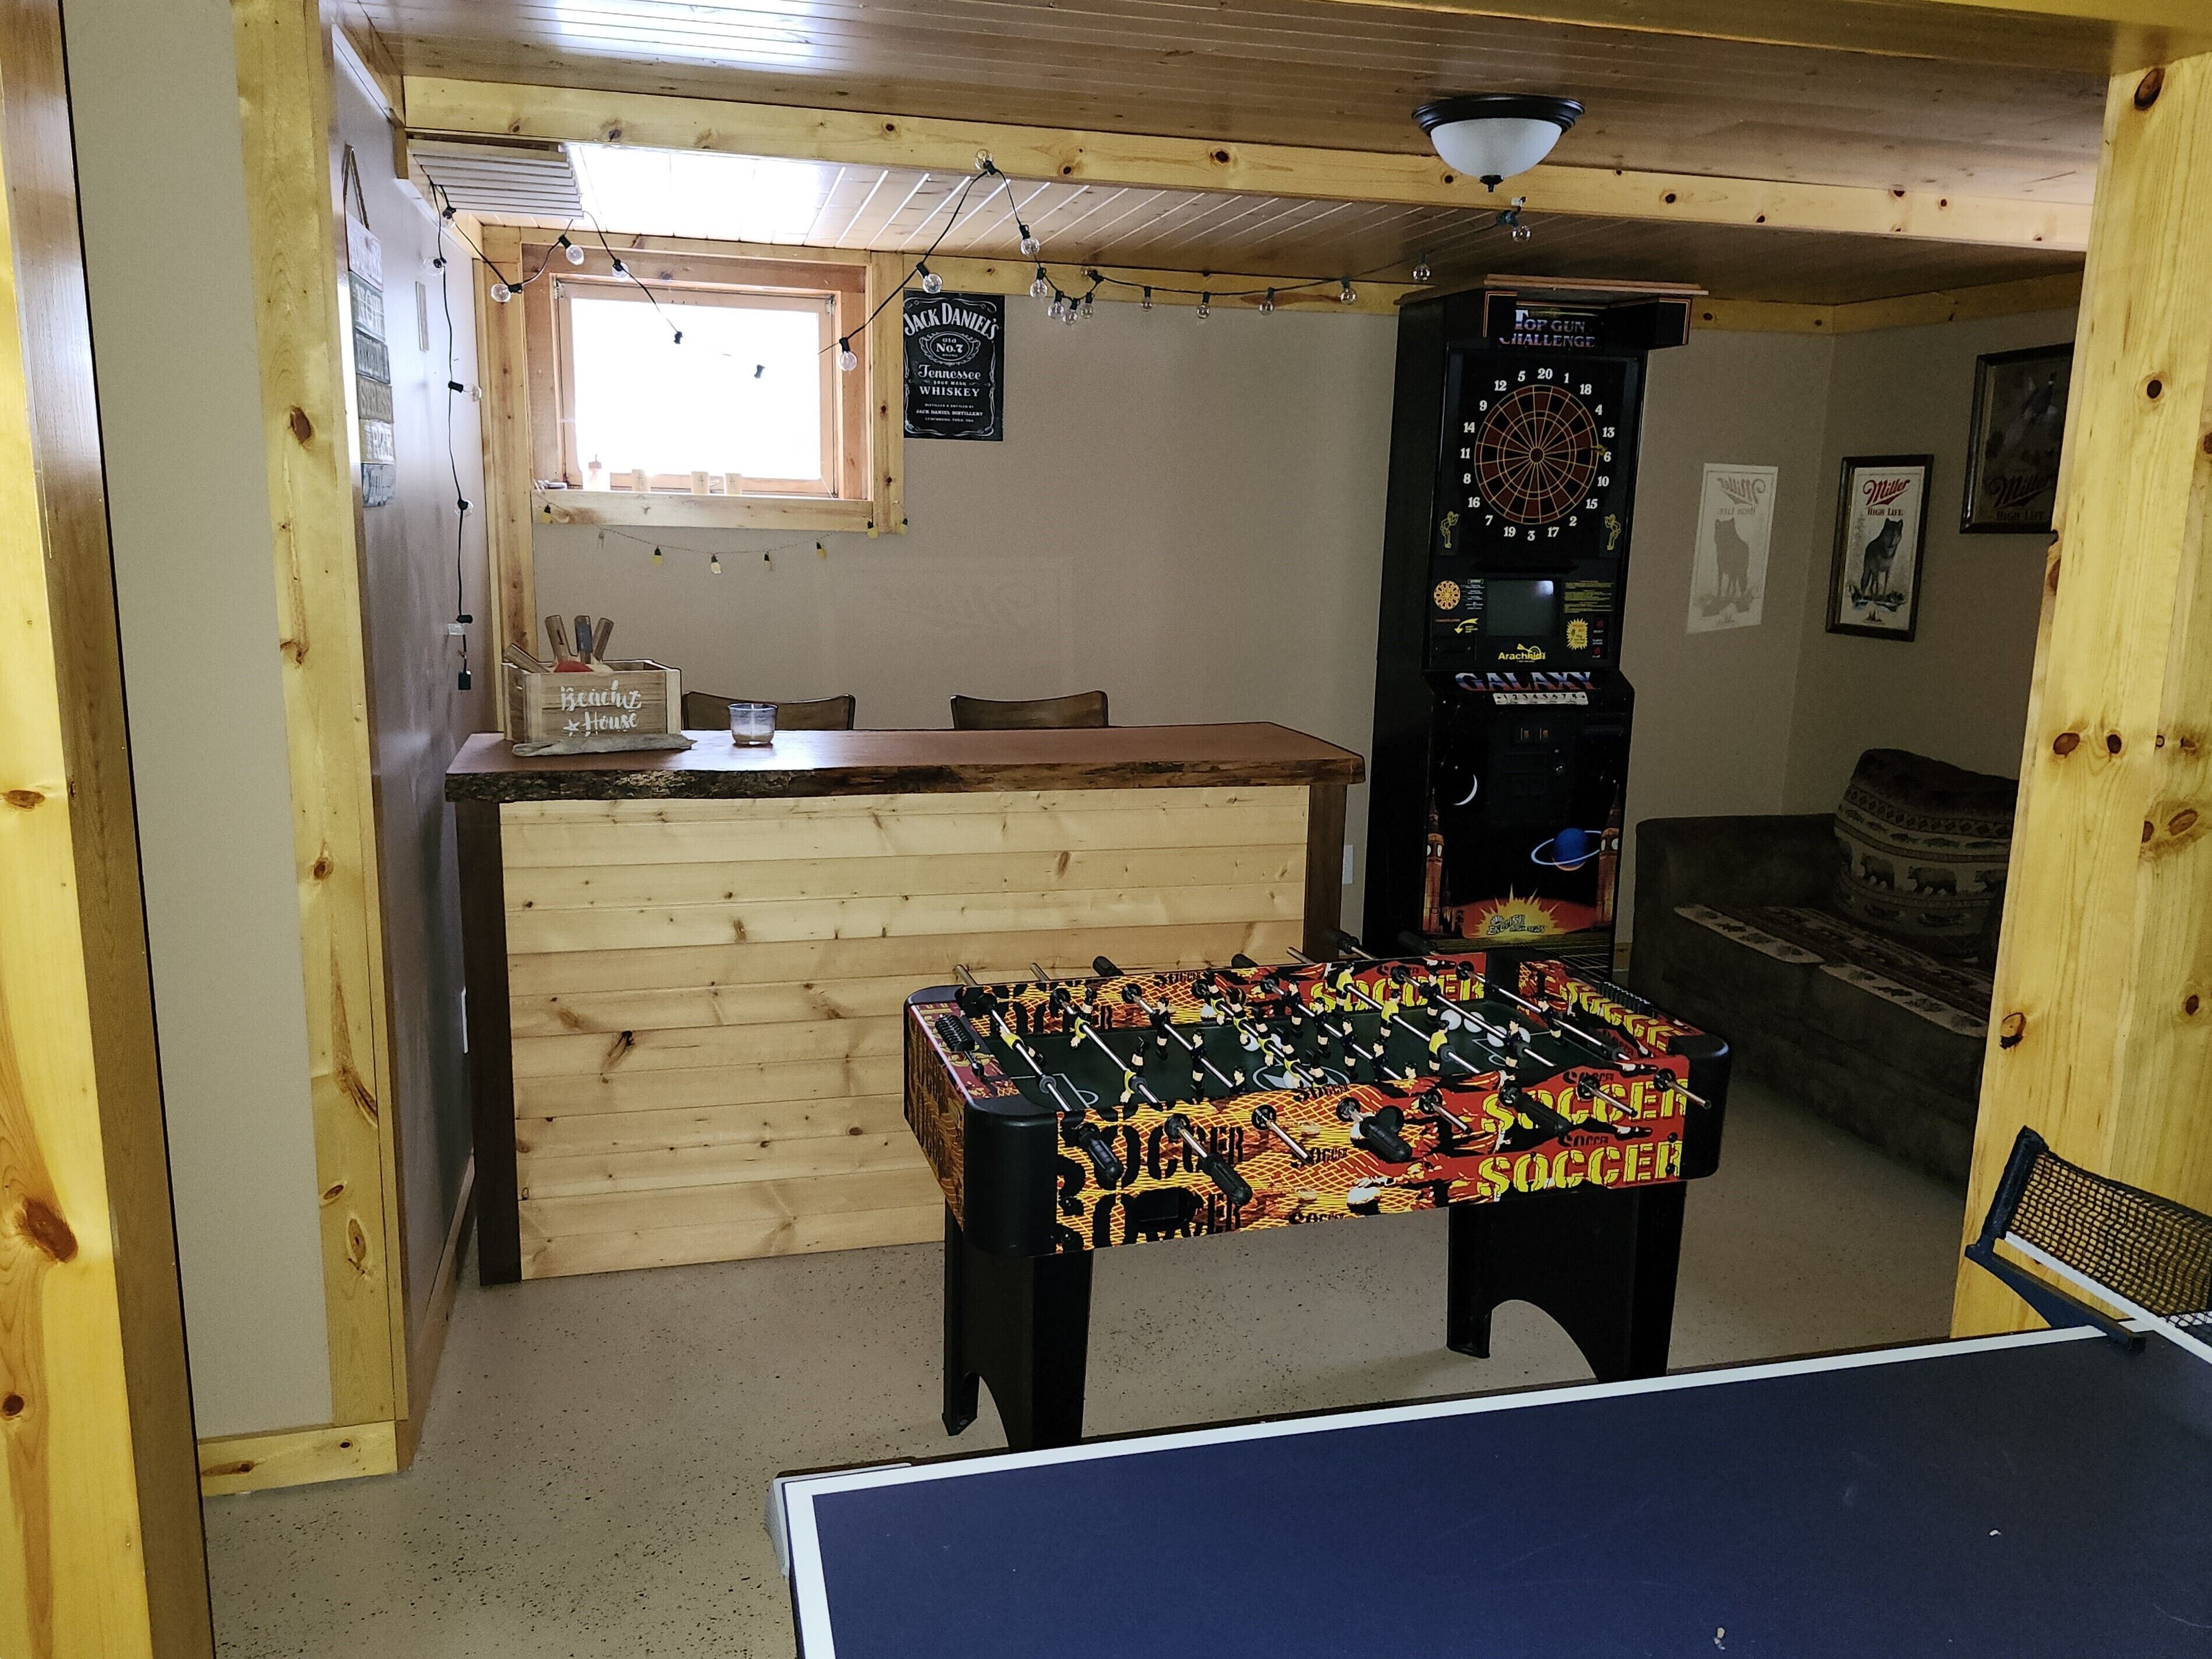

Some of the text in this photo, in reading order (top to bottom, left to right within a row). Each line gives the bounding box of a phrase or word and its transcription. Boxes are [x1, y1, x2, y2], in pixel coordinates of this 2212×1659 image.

[355, 283, 382, 335] NOW
[903, 302, 999, 340] JACK DANIEL'S
[1514, 309, 1585, 332] TOP GUN
[918, 365, 981, 380] Tennessee
[1517, 370, 1526, 382] 5
[1537, 367, 1553, 380] 20
[1564, 372, 1569, 384] 1
[1494, 380, 1507, 391] 12
[1580, 383, 1592, 395] 18
[919, 386, 980, 397] WHISKEY
[358, 377, 392, 419] STRESS
[1479, 399, 1487, 411] 9
[1595, 404, 1603, 416] 4
[1463, 422, 1475, 433] 14
[1602, 427, 1615, 438] 13
[1460, 448, 1471, 459] 11
[1603, 451, 1612, 462] 6
[1463, 473, 1471, 484] 8
[1597, 476, 1609, 487] 10
[1863, 478, 1910, 505] Miller
[1468, 497, 1480, 508] 16
[1585, 499, 1598, 510] 15
[1485, 515, 1493, 526] 7
[1569, 516, 1577, 526] 2
[1503, 526, 1516, 537] 19
[1527, 530, 1535, 541] 3
[1547, 526, 1560, 537] 17
[1455, 671, 1600, 691] GALAXY
[581, 709, 638, 737] House
[1477, 1145, 1683, 1197] SOCCER
